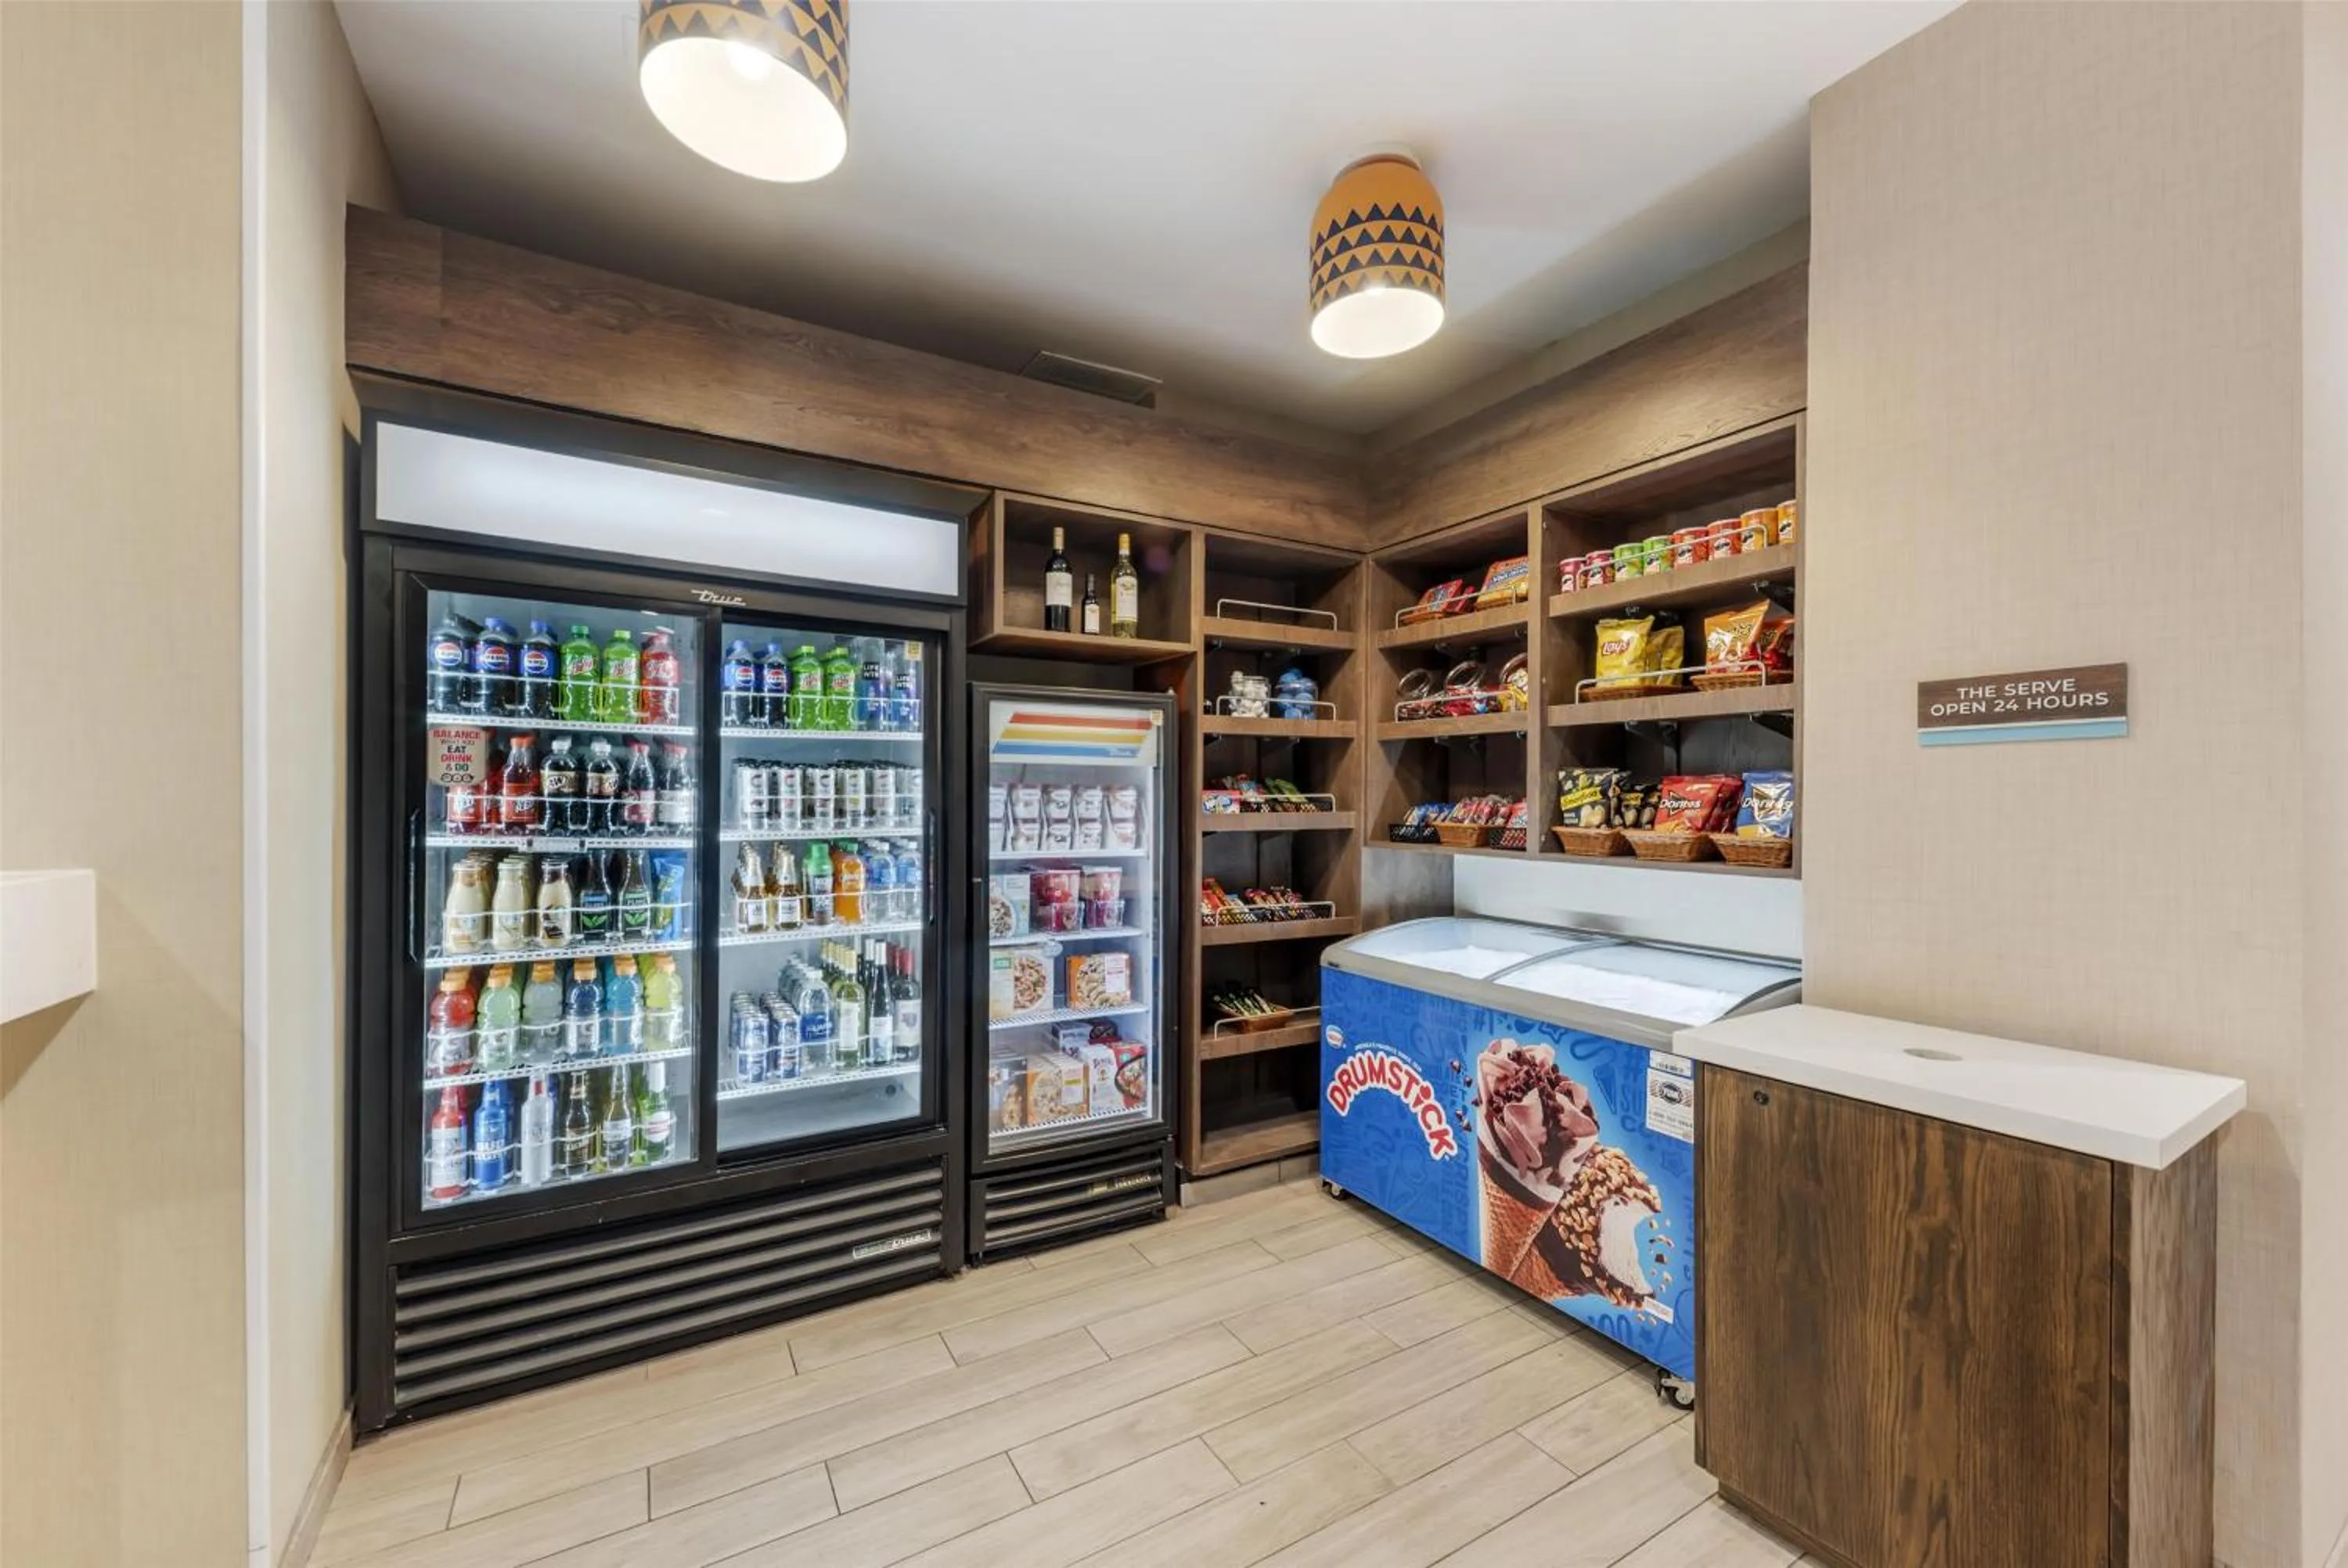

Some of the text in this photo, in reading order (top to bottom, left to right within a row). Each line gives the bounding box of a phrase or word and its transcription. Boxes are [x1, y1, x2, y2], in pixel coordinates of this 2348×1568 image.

[1957, 678, 2076, 699] THE SERVE
[1930, 692, 2109, 717] OPEN 24 HOURS
[433, 729, 481, 739] BALANCE
[441, 753, 473, 763] DRINK
[455, 763, 469, 771] DO
[1659, 798, 1702, 809] Doritos
